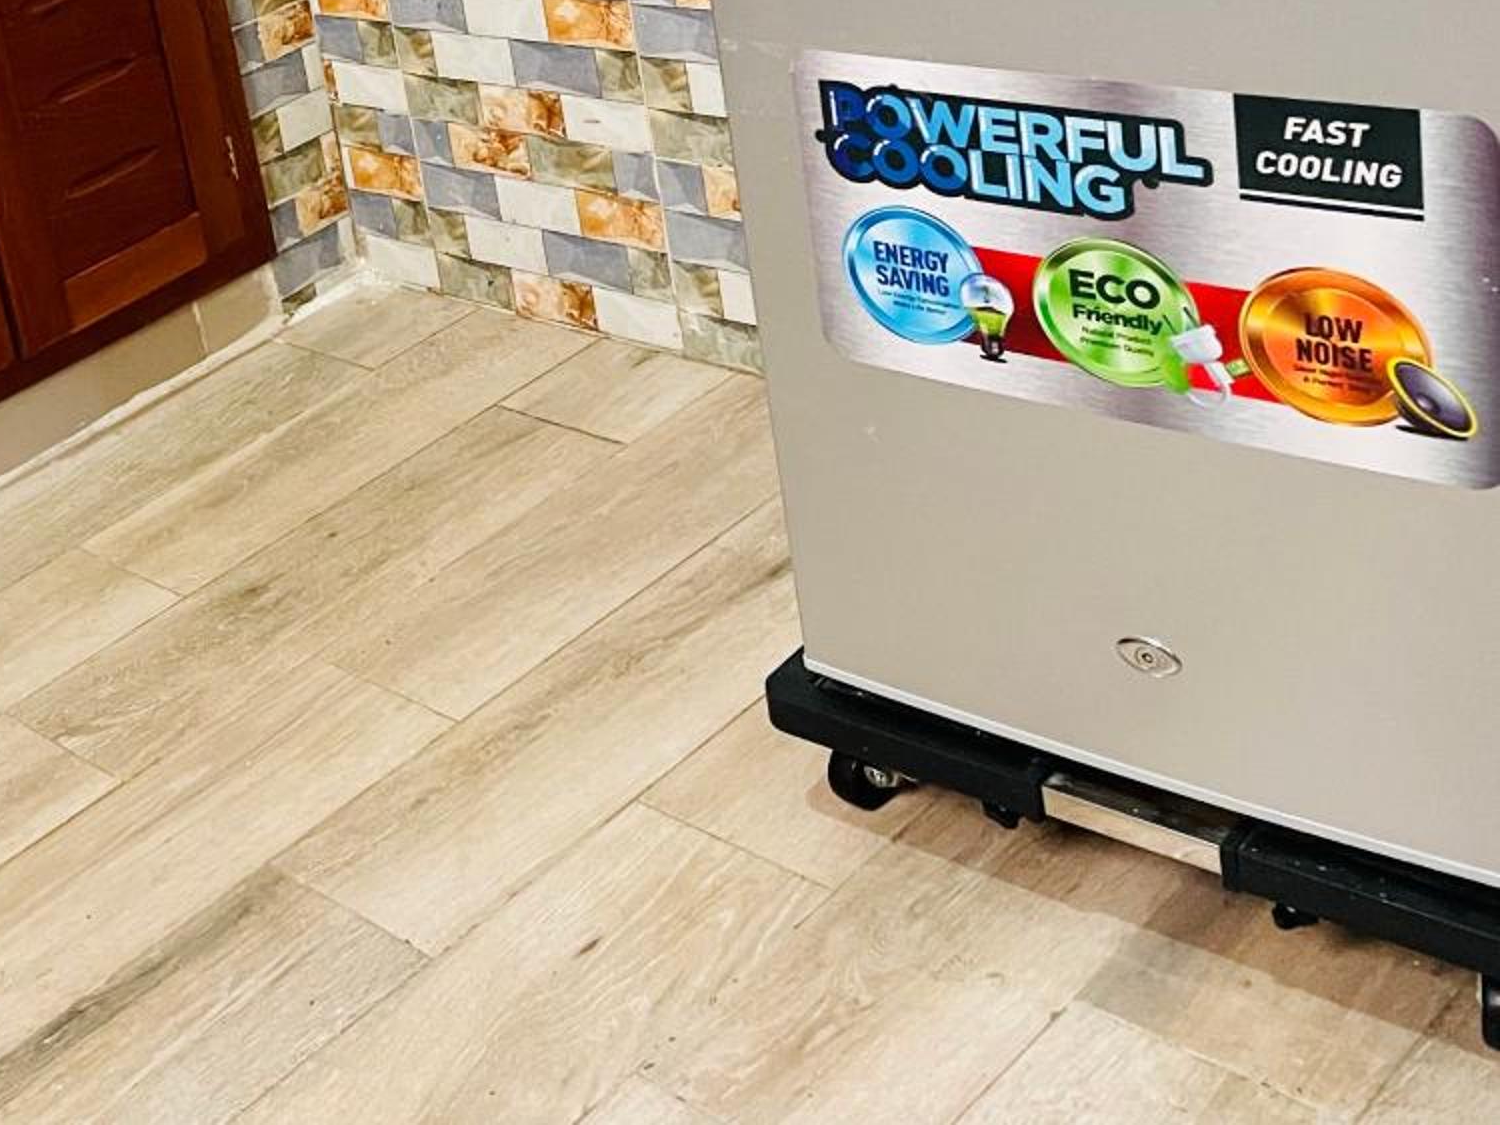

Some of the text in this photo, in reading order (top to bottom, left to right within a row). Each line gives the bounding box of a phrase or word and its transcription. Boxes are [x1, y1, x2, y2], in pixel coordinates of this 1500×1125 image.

[826, 87, 1205, 180] POWERFUL
[1284, 116, 1371, 148] FAST
[833, 131, 1126, 215] COOLING
[1255, 150, 1403, 189] COOLING
[873, 241, 949, 273] ENERGY
[876, 264, 950, 297] SAVING
[1068, 269, 1161, 310] ECO
[1072, 303, 1163, 336] Friendly
[1304, 313, 1362, 344] LOW
[1296, 337, 1373, 373] NOISE
